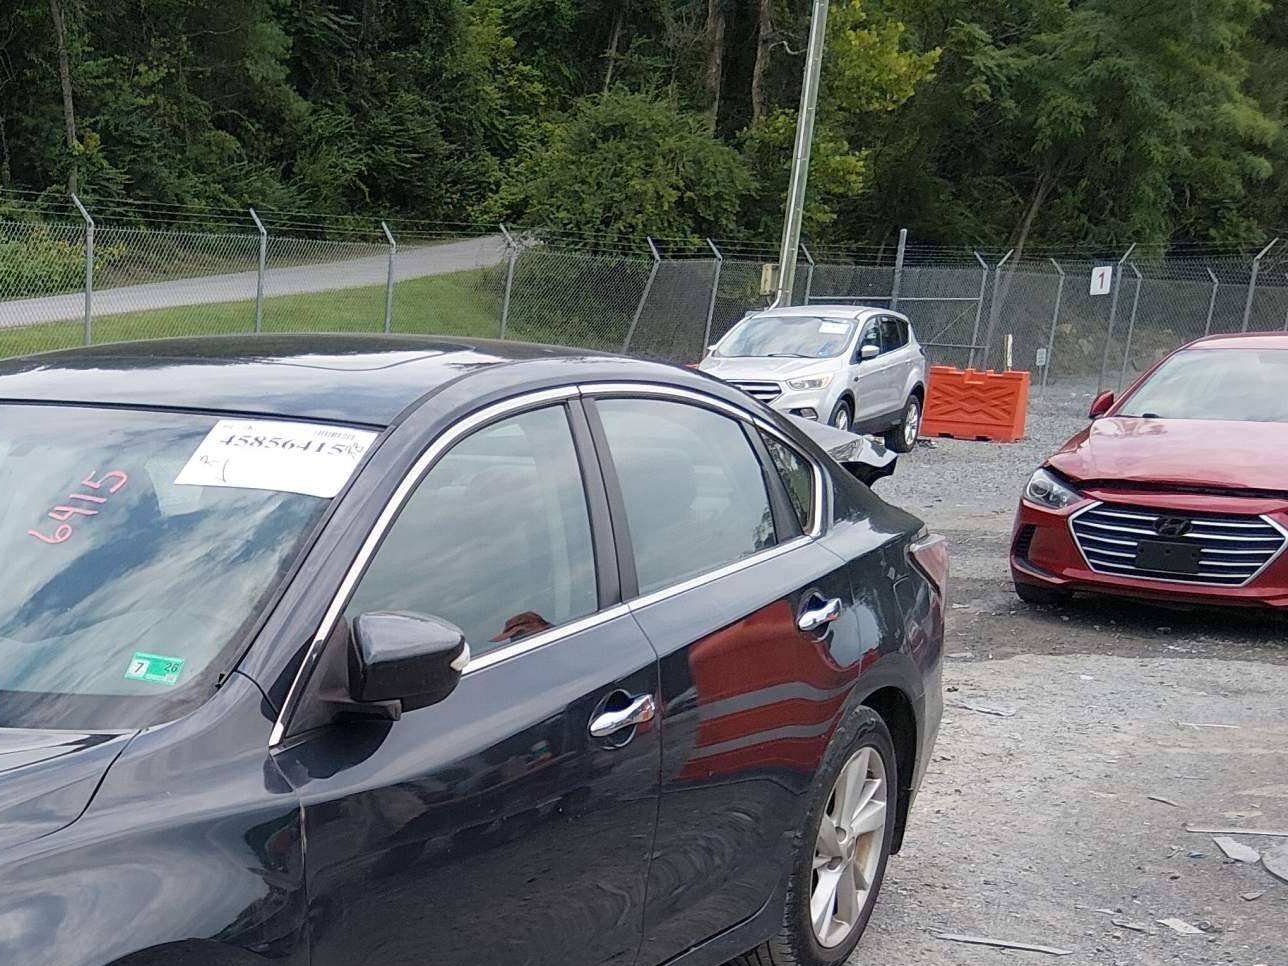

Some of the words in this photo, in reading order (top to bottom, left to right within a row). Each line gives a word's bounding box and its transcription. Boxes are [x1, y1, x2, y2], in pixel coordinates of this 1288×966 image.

[1098, 272, 1106, 289] 1
[219, 434, 346, 456] 45856415
[26, 469, 129, 545] 6415
[134, 662, 145, 673] 7
